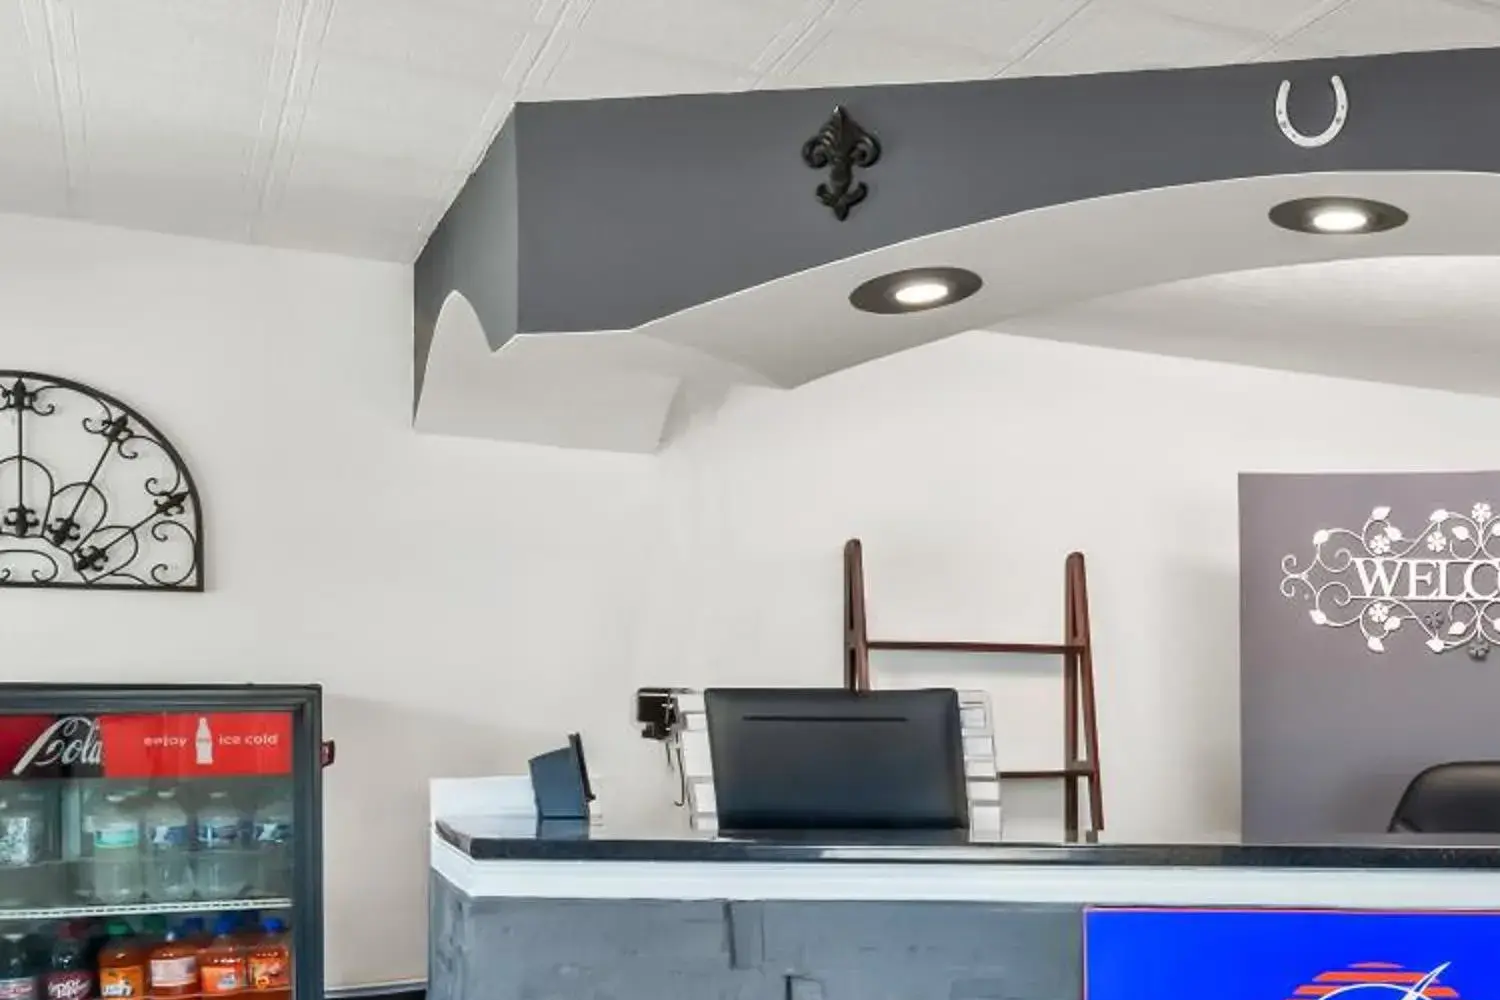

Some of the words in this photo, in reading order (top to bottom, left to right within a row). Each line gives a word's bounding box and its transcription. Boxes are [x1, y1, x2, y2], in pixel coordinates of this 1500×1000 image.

[12, 716, 103, 775] Cola
[143, 734, 188, 748] enjoy
[218, 733, 241, 745] ice
[244, 733, 279, 746] cold
